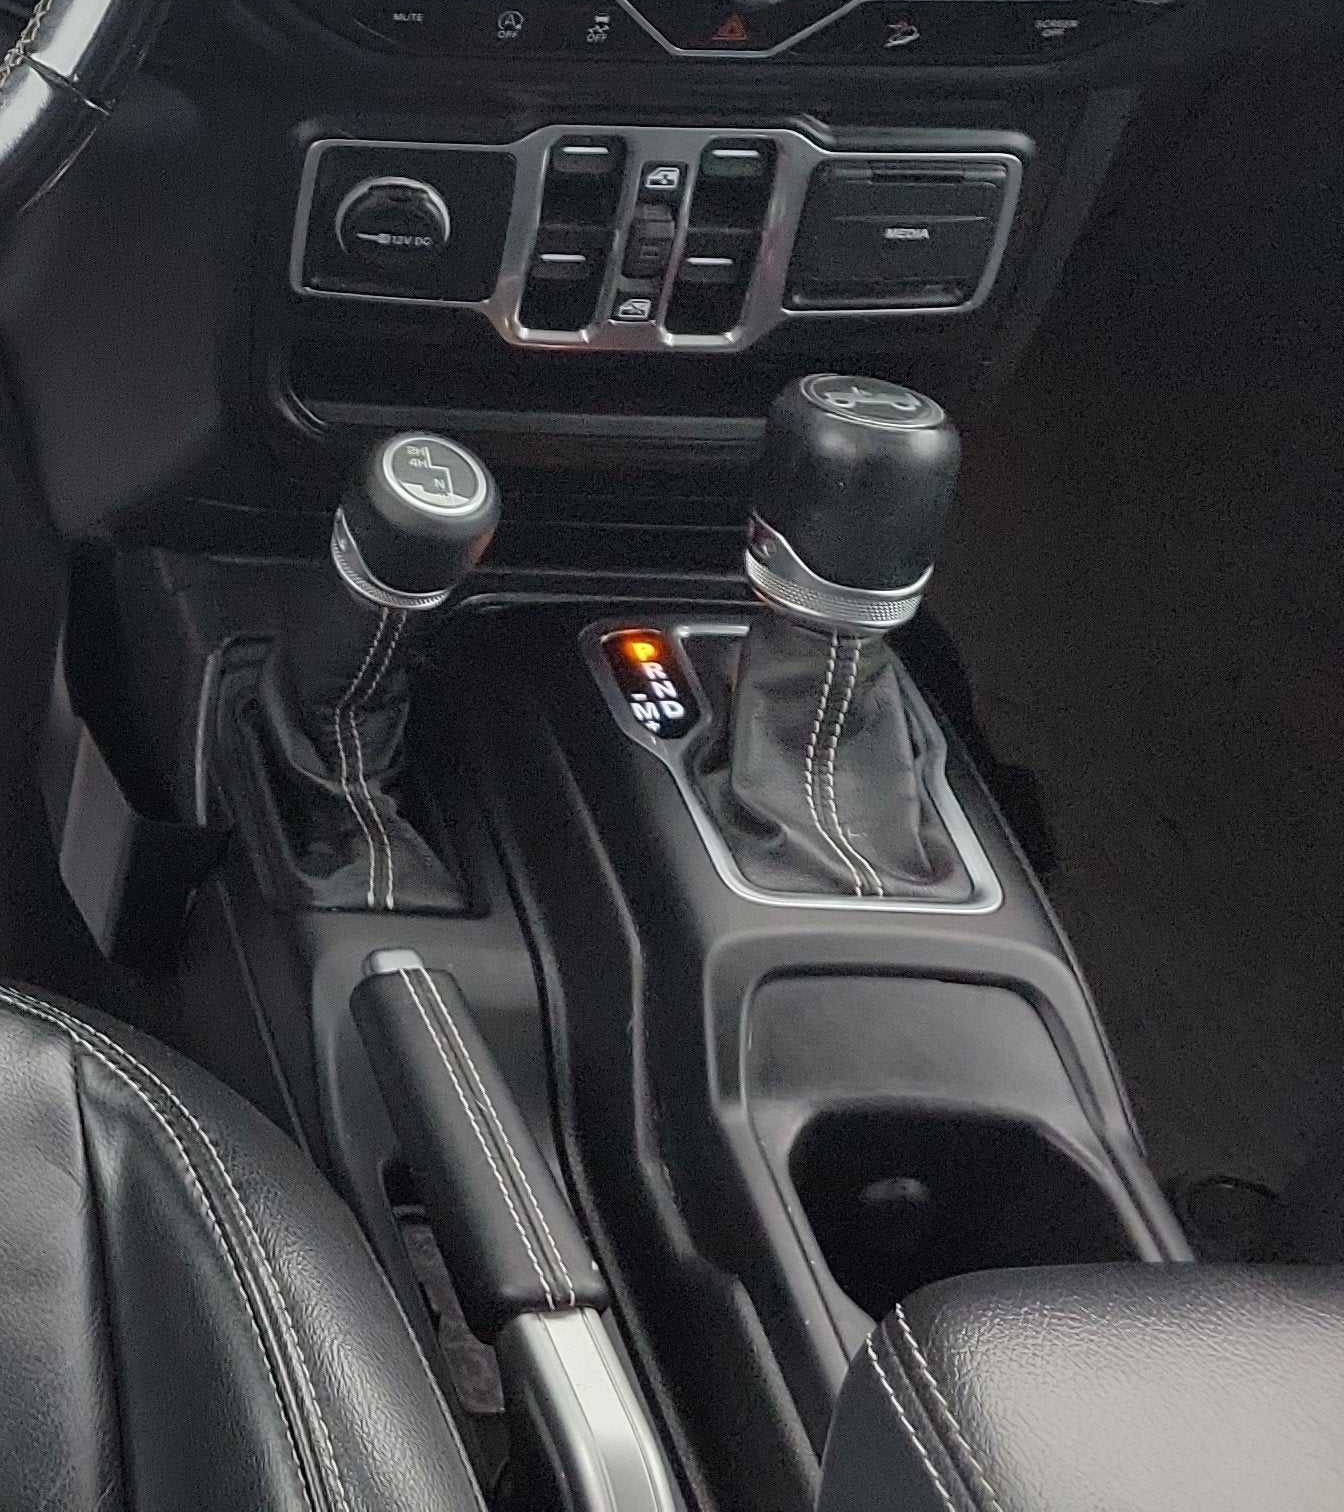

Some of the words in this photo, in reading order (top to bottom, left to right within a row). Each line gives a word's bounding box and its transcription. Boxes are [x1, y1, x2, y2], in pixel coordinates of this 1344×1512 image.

[393, 13, 423, 22] MUTE
[632, 642, 656, 662] P
[642, 661, 668, 680] R
[650, 680, 677, 699] N
[630, 701, 661, 721] M
[658, 700, 685, 720] D
